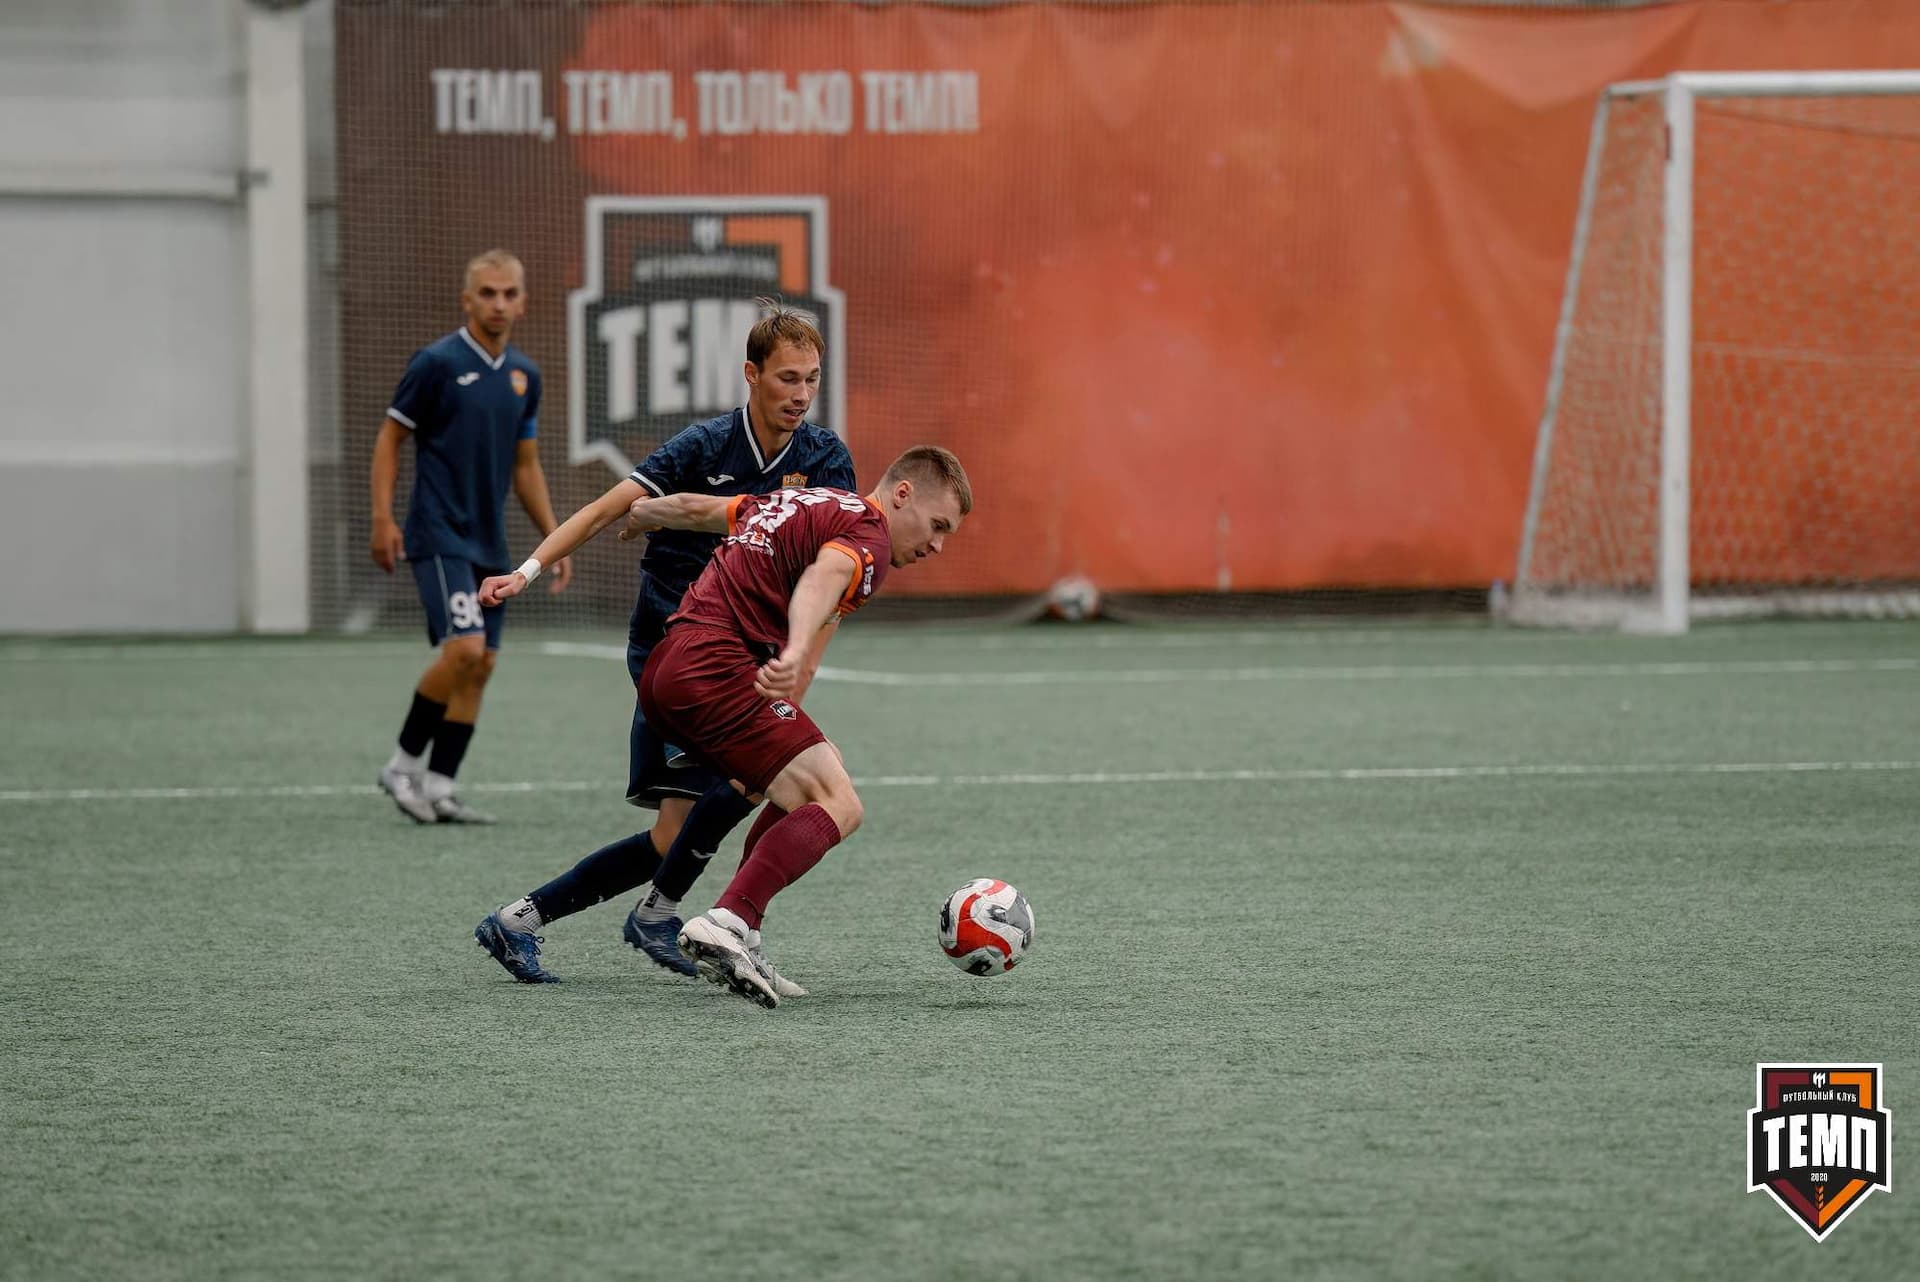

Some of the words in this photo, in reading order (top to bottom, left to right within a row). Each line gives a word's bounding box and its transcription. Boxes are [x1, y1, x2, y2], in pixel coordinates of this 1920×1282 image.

[433, 69, 556, 141] ТЕМП,
[564, 70, 687, 140] ТЕМП,
[695, 70, 851, 136] ТОЛЬКО
[862, 70, 979, 134] ТЕМП!
[597, 297, 820, 424] ТЕМ
